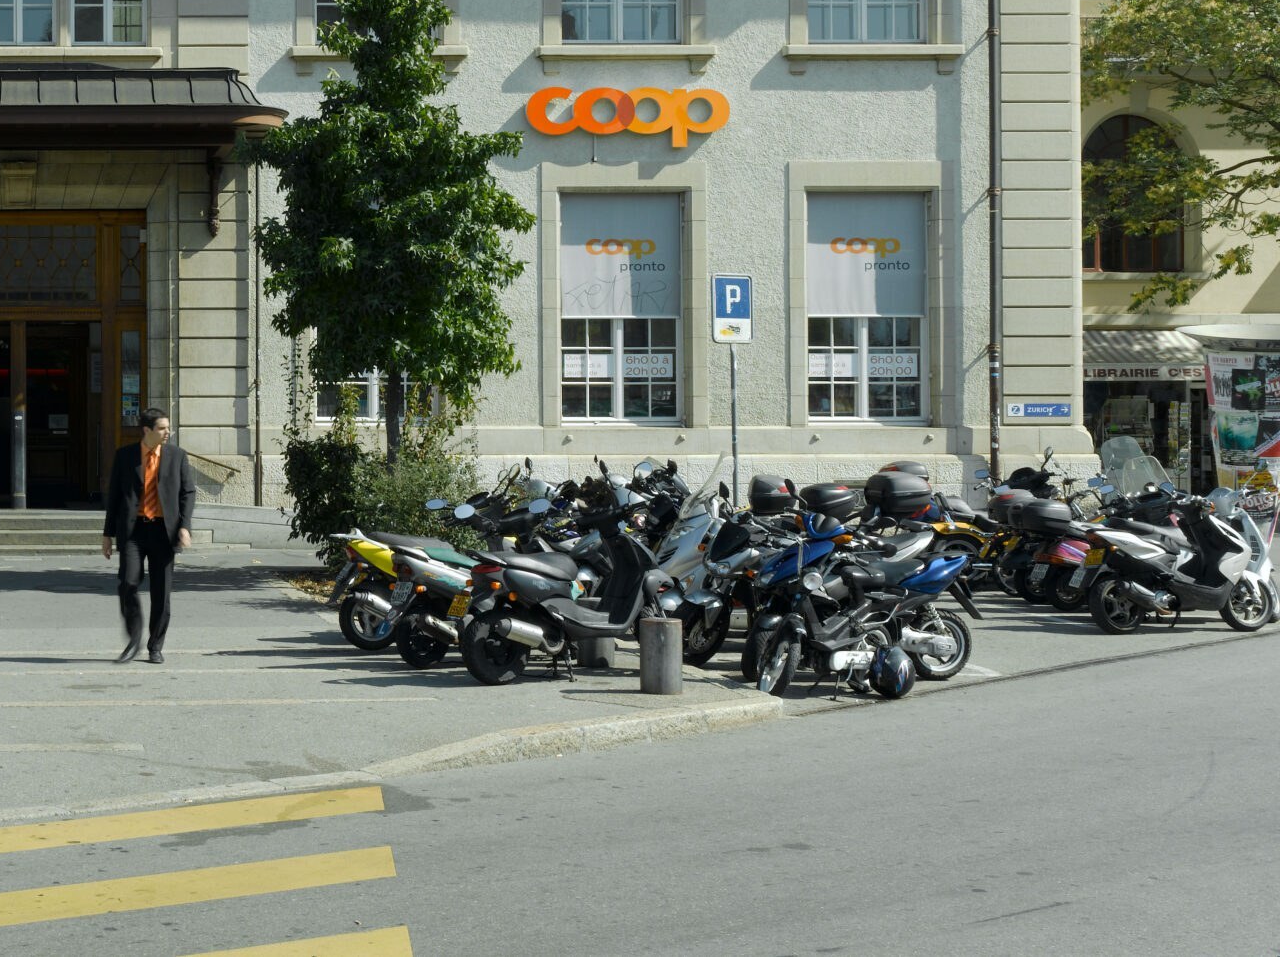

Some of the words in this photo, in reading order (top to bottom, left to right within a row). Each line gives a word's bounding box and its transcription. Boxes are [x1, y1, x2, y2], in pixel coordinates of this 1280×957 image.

[526, 87, 730, 148] coop
[585, 238, 657, 260] coop
[830, 237, 901, 259] coop
[619, 262, 666, 273] pronto
[864, 261, 911, 272] pronto
[726, 284, 741, 314] P
[662, 355, 670, 365] à
[906, 355, 914, 364] à
[1083, 368, 1159, 378] LIBRAIRIE
